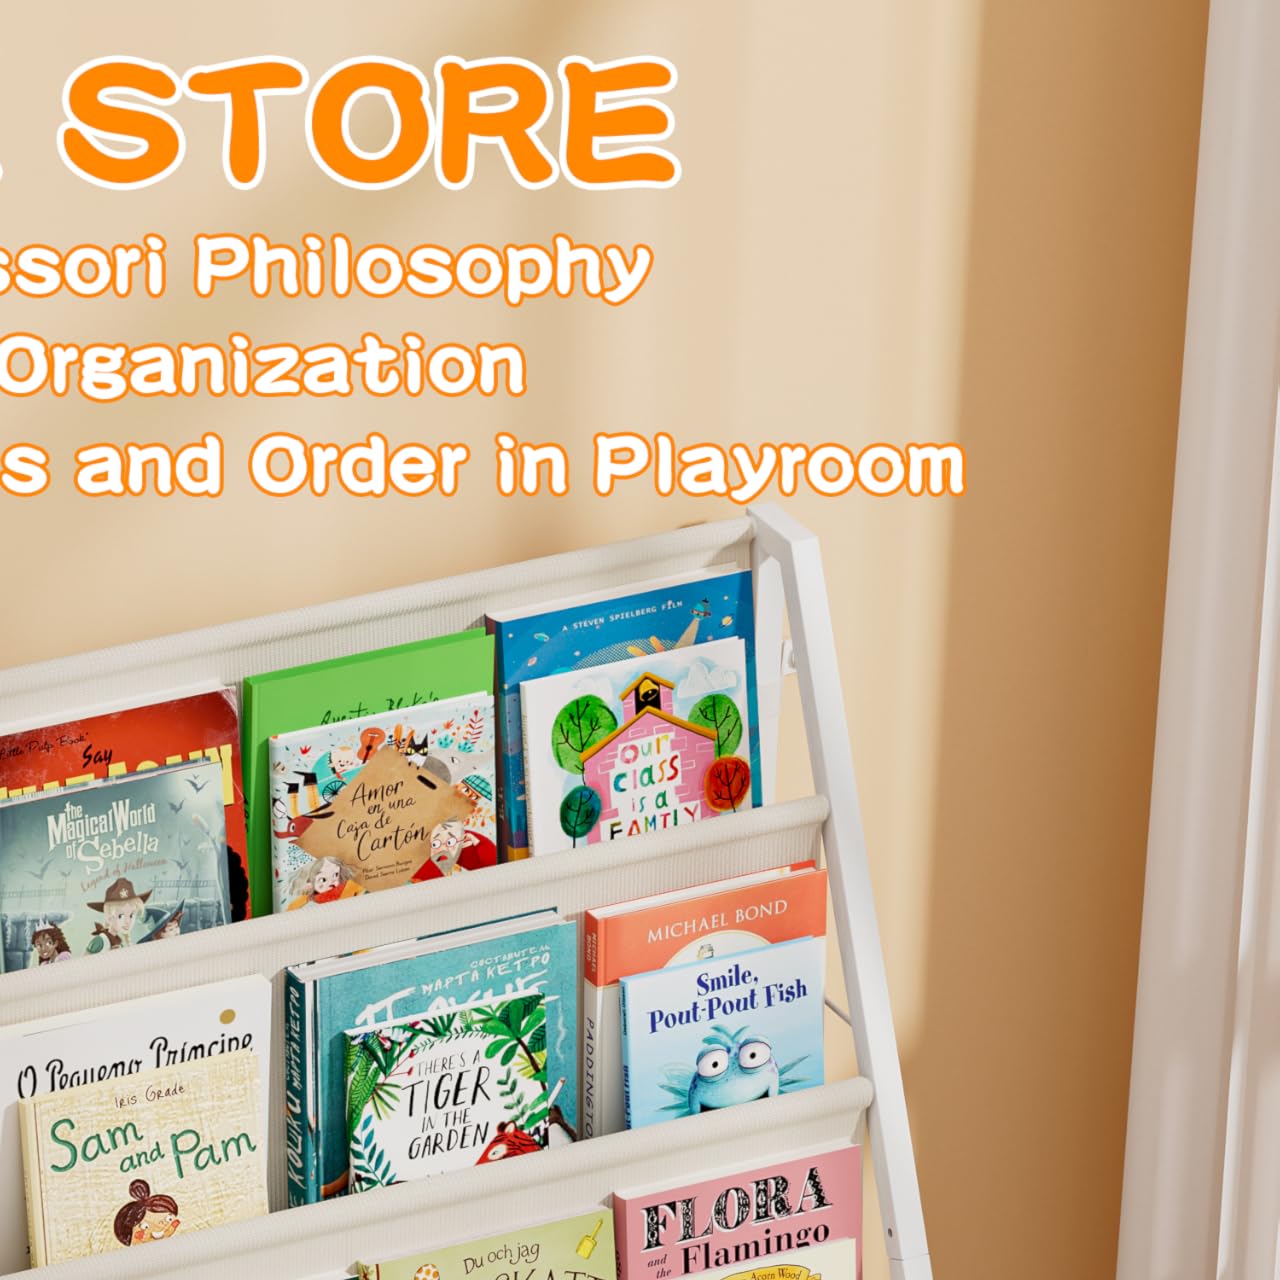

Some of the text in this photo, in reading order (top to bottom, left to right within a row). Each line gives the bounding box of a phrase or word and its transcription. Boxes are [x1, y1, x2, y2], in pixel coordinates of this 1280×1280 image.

[572, 617, 605, 630] STEVEN
[609, 605, 657, 622] SPIELBERG
[82, 744, 113, 768] Say
[350, 780, 404, 807] Amor
[367, 797, 416, 815] en una
[631, 790, 668, 813] is a
[47, 798, 156, 852] Magical World
[64, 801, 83, 821] the
[337, 810, 392, 842] Caja de
[65, 831, 159, 875] of Sebella
[357, 822, 430, 862] Cartón
[647, 898, 788, 944] MICHAEL BOND
[421, 951, 551, 995] МАРТА КЕТРО
[696, 963, 759, 997] Smile,
[646, 995, 759, 1034] Pout-Pout
[763, 978, 808, 1009] Fish
[417, 1049, 481, 1077] THERE'S A
[585, 1016, 595, 1139] PADDINGTO
[17, 1064, 38, 1099] O
[401, 1066, 491, 1117] TIGER
[421, 1107, 473, 1133] IN THE
[49, 1118, 144, 1173] Sam
[120, 1129, 257, 1179] and Pam
[408, 1121, 489, 1160] GARDEN
[640, 1166, 834, 1253] FLORA
[463, 1242, 540, 1274] Du och jag
[647, 1254, 667, 1268] and
[680, 1224, 830, 1276] Flamingo
[656, 1267, 672, 1280] the
[777, 1267, 802, 1280] Wood
